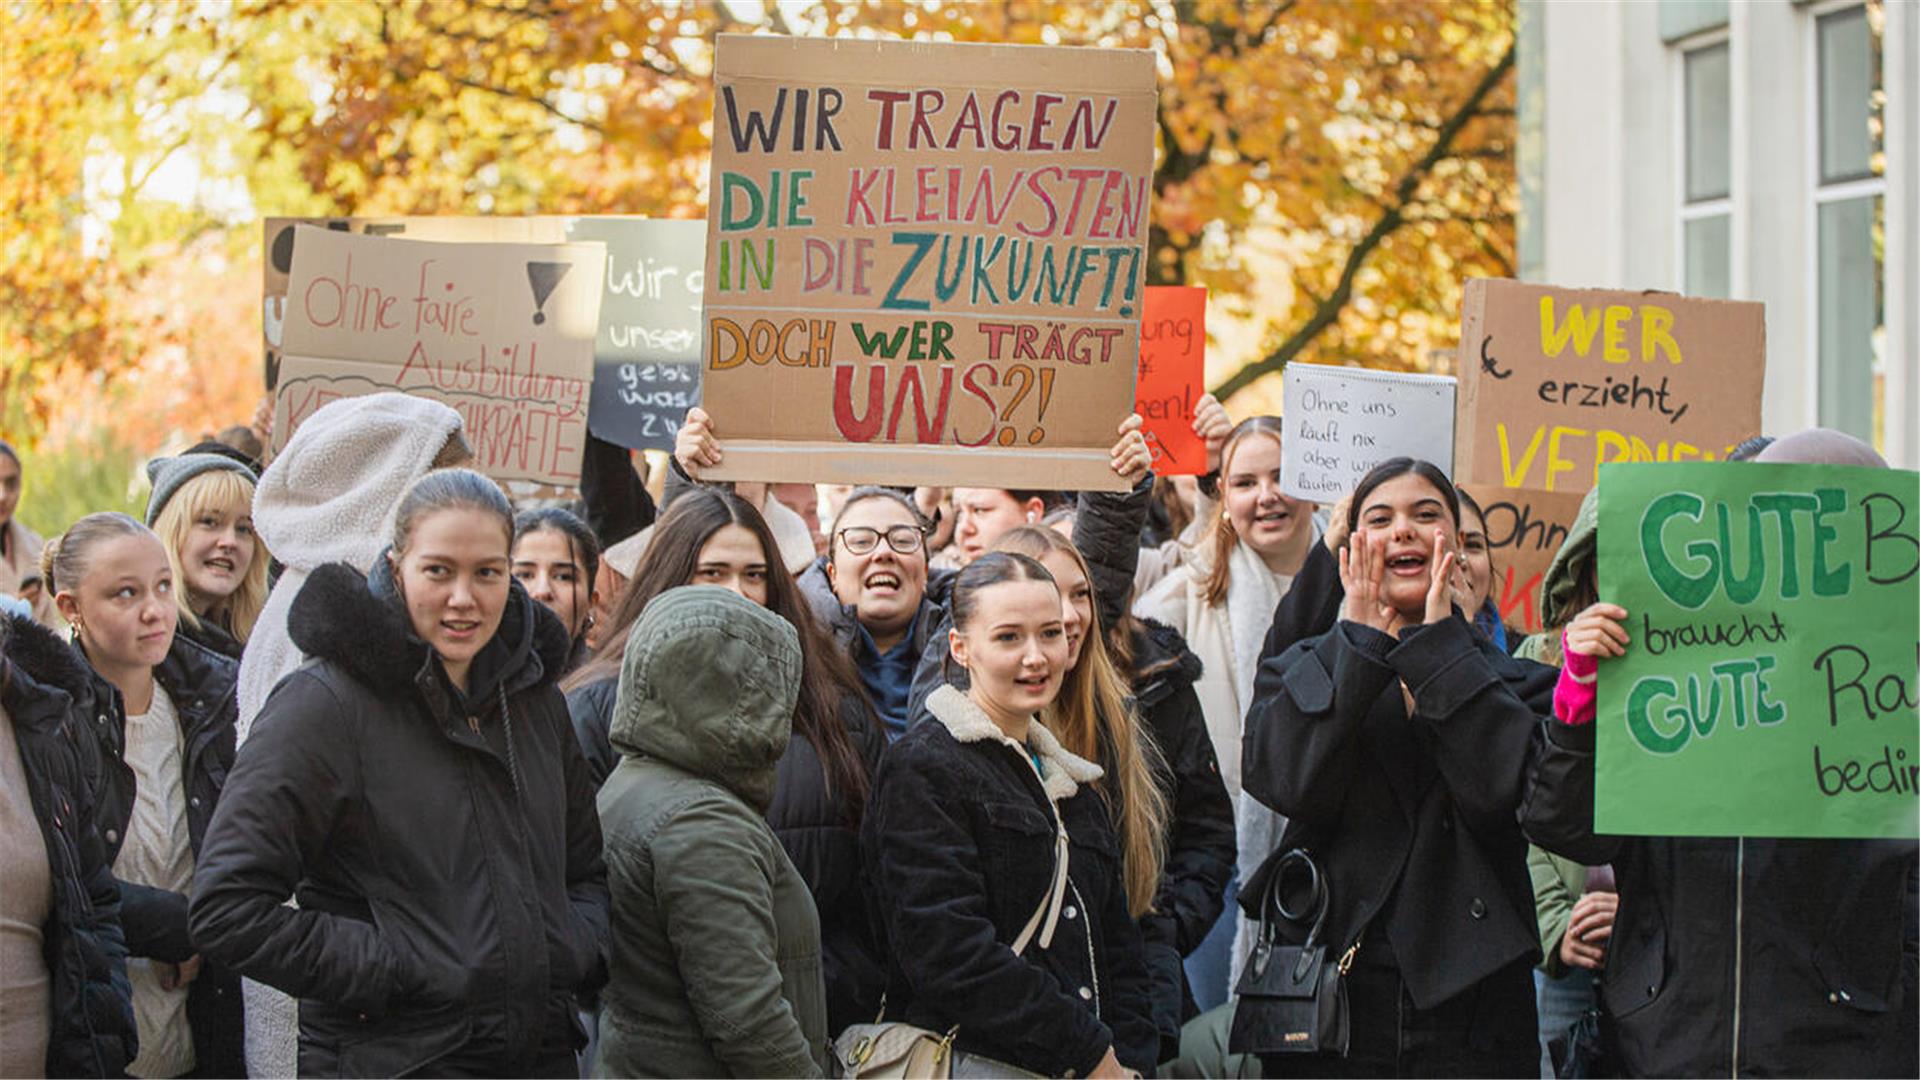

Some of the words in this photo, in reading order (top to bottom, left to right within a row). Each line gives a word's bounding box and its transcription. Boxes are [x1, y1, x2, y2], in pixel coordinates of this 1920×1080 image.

[721, 86, 843, 154] WIR
[867, 89, 1118, 153] TRAGEN
[719, 170, 815, 233] DIE
[845, 165, 1147, 239] KLEINSTEN
[305, 252, 401, 333] Ohne
[414, 259, 479, 336] faire
[717, 238, 776, 292] IN
[803, 238, 875, 296] DIE
[880, 232, 1143, 318] ZUKUNFT!
[710, 318, 836, 370] DOCH
[852, 321, 955, 361] WER
[979, 322, 1123, 364] TRÄGT
[1539, 295, 1683, 365] WER
[396, 341, 583, 417] Ausbildung
[833, 363, 1056, 448] UNS?!
[1302, 389, 1349, 414] Ohne
[1361, 403, 1397, 417] uns
[1538, 375, 1688, 424] erzieht,
[1303, 450, 1341, 470] aber
[1352, 433, 1376, 447] nix
[1640, 488, 1852, 610] GUTE
[1644, 611, 1787, 656] braucht
[1625, 655, 1787, 755] GUTE
[1813, 641, 1919, 727] Ra
